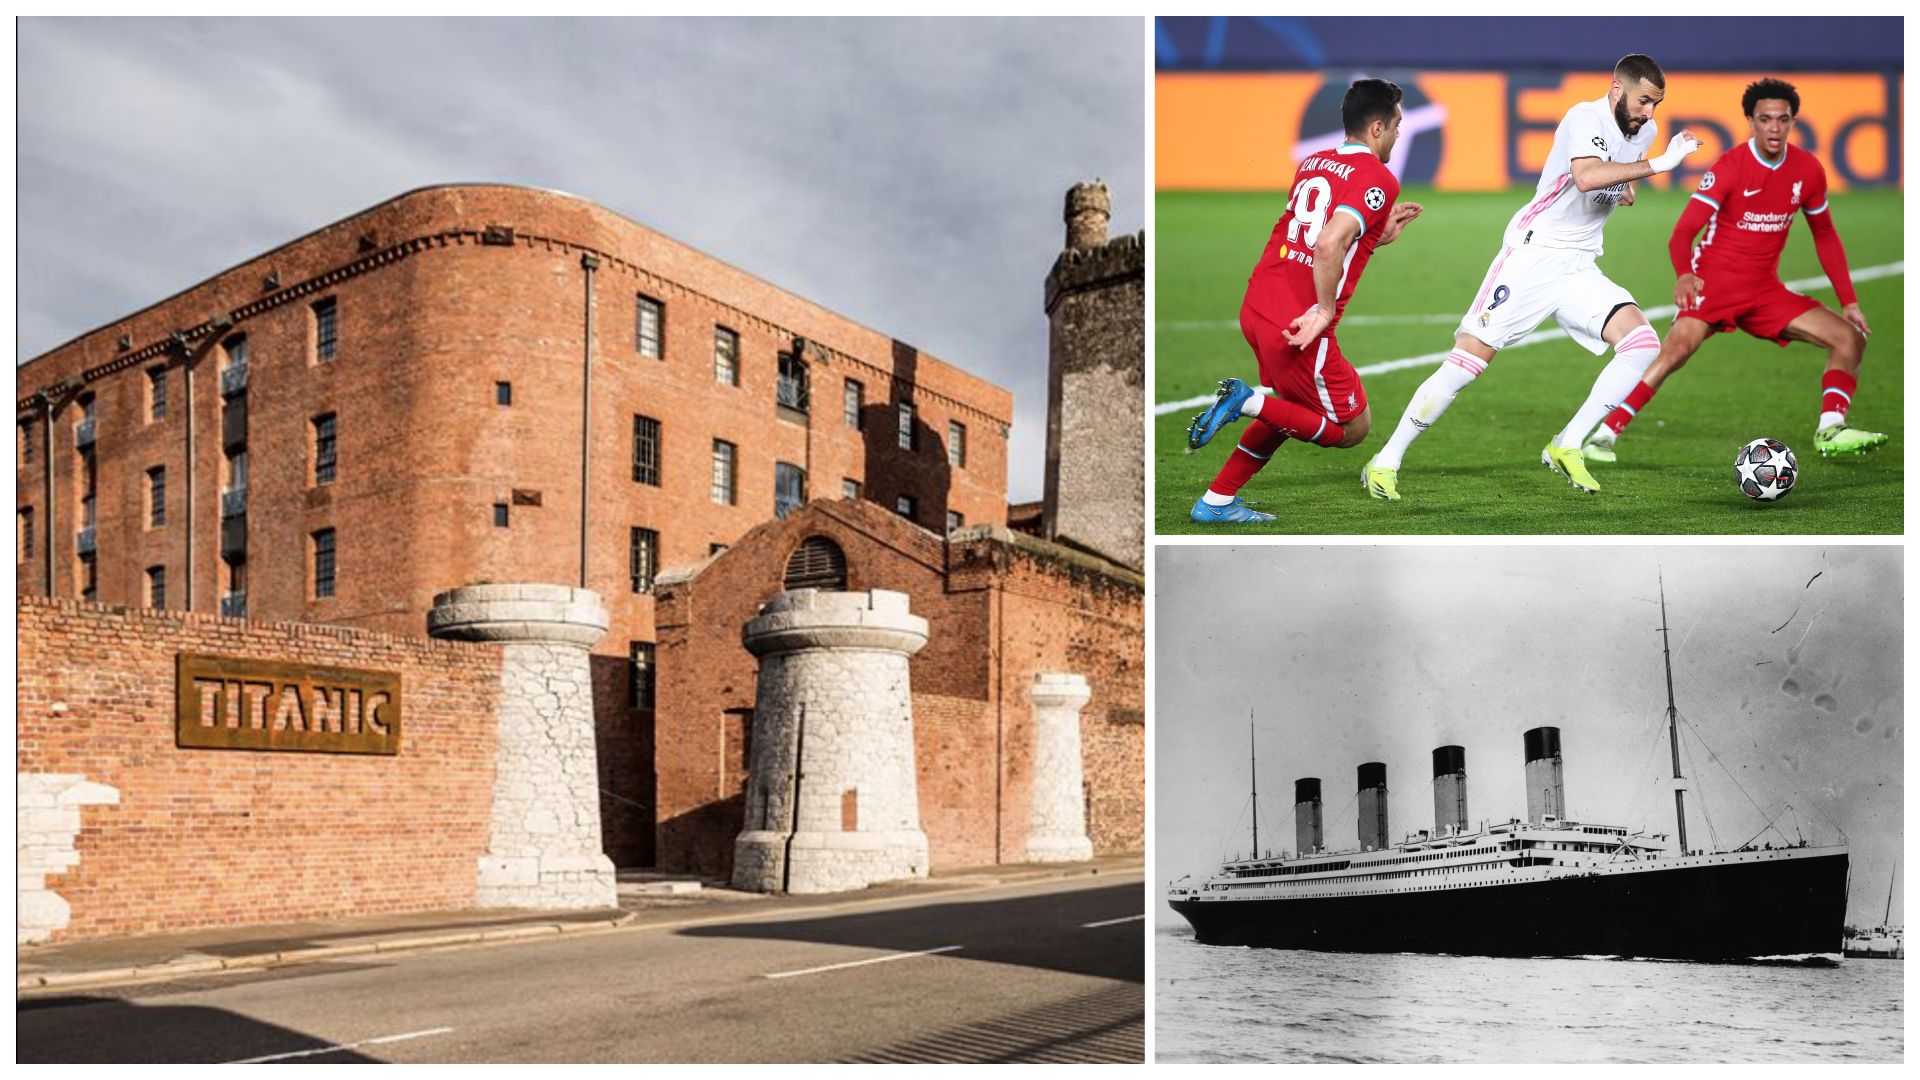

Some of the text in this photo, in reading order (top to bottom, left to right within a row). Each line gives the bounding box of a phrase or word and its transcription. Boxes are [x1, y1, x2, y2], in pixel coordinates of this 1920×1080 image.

[1507, 71, 1900, 185] Epd
[1300, 157, 1321, 171] ZAN
[1287, 176, 1332, 250] 19
[1743, 211, 1788, 222] Standard
[1736, 220, 1784, 232] Chartered
[1304, 255, 1314, 268] PL
[1487, 284, 1511, 310] 9
[193, 676, 391, 735] TITANIC
